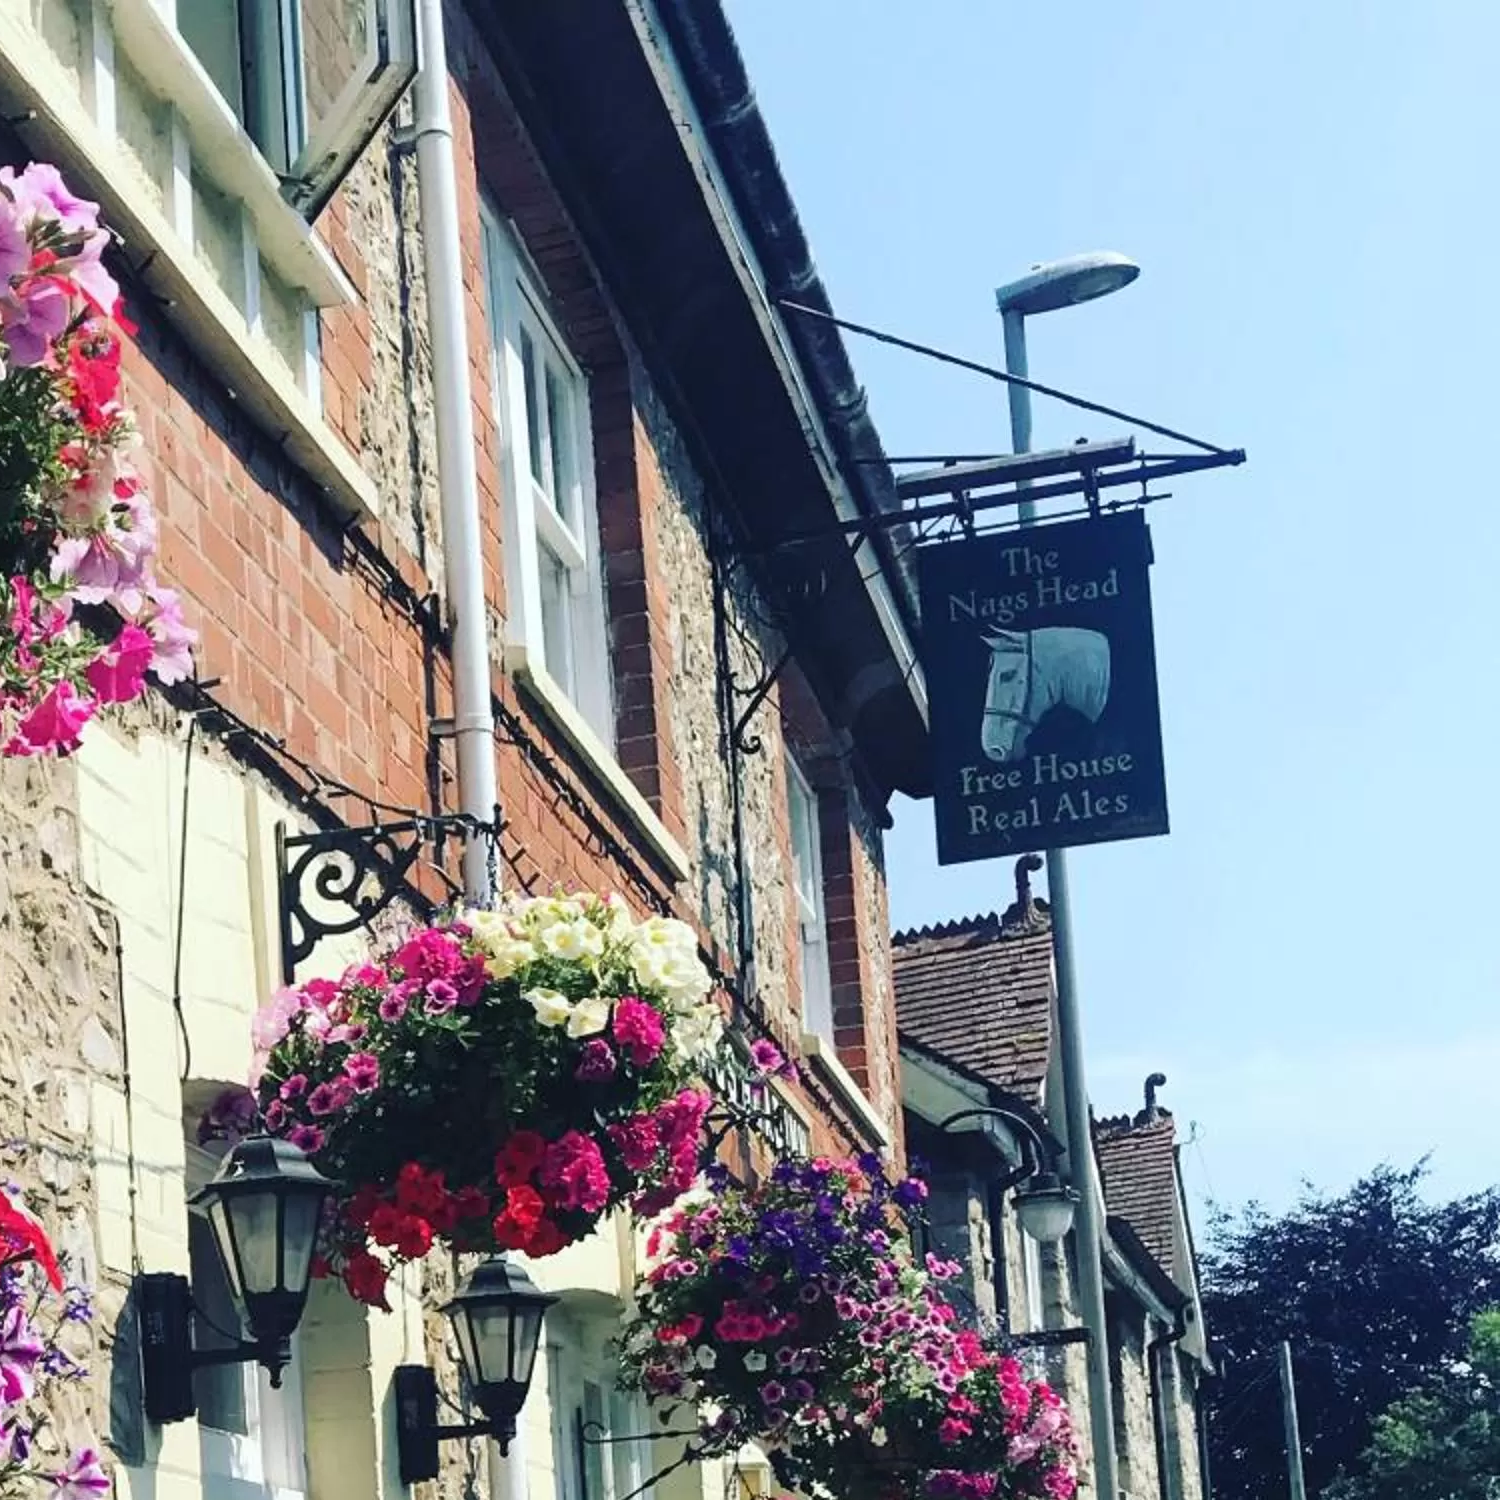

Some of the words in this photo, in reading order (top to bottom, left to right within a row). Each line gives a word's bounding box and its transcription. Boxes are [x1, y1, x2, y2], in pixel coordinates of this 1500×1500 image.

[1002, 547, 1060, 577] The
[949, 590, 1029, 623] Nags
[1036, 567, 1120, 608] Head
[960, 766, 1023, 795] Free
[1032, 752, 1134, 785] House
[967, 798, 1041, 835] Real
[1053, 788, 1129, 823] Ales
